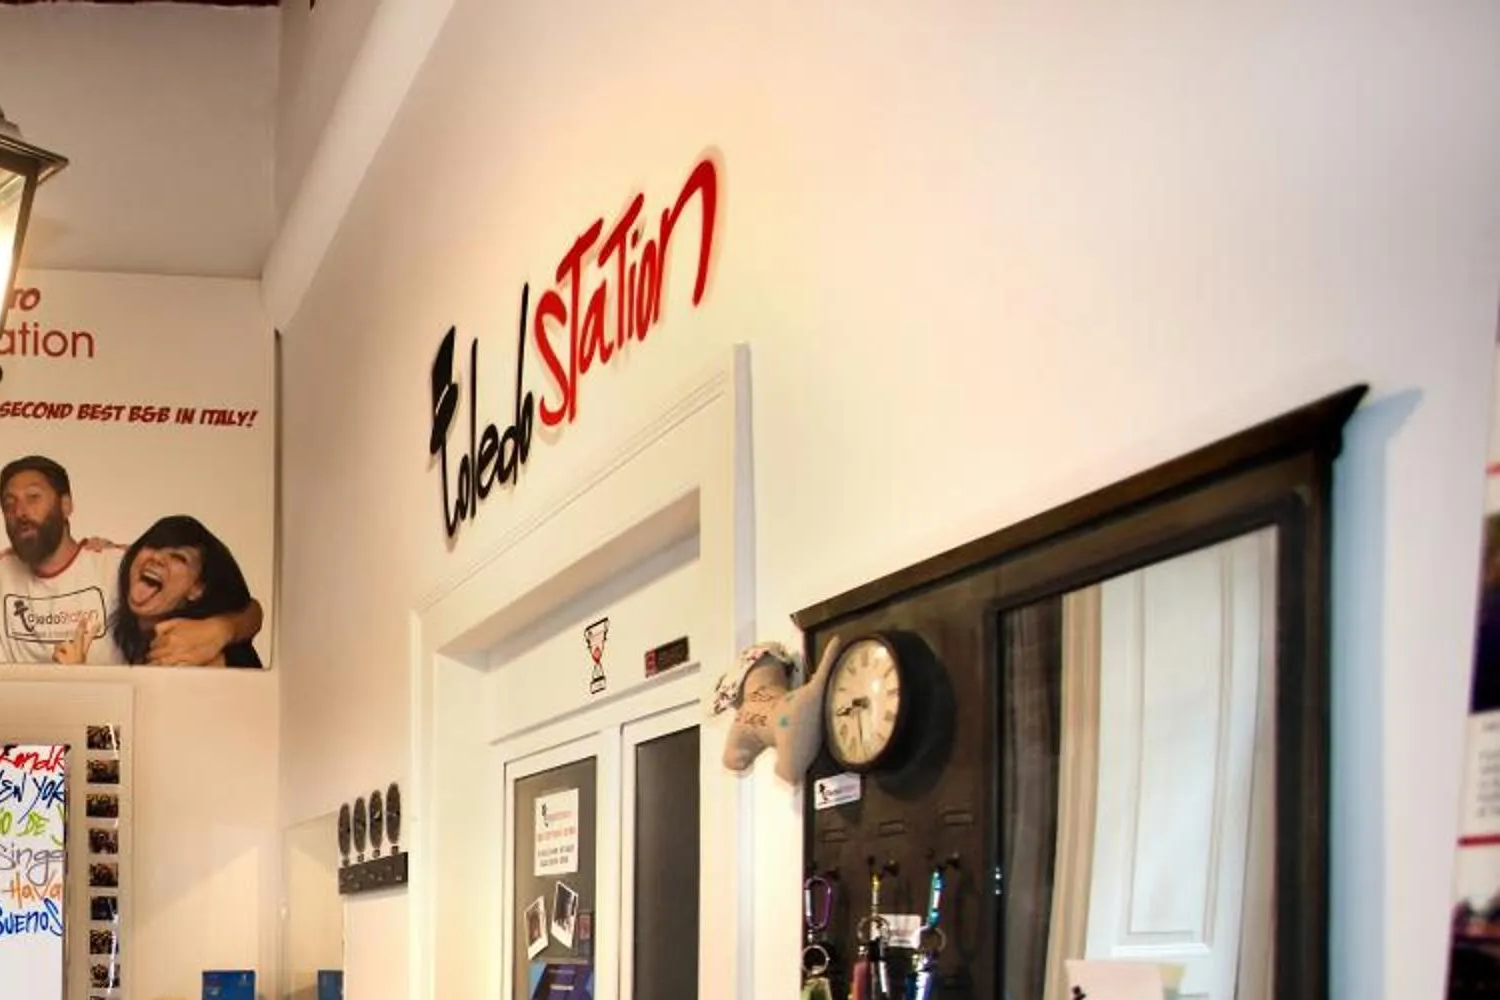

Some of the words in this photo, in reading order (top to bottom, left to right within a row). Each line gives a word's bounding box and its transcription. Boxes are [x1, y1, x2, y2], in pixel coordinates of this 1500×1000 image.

[76, 403, 127, 421] BEST
[128, 405, 171, 424] B&B
[175, 407, 196, 425] IN
[199, 408, 259, 428] ITALY!
